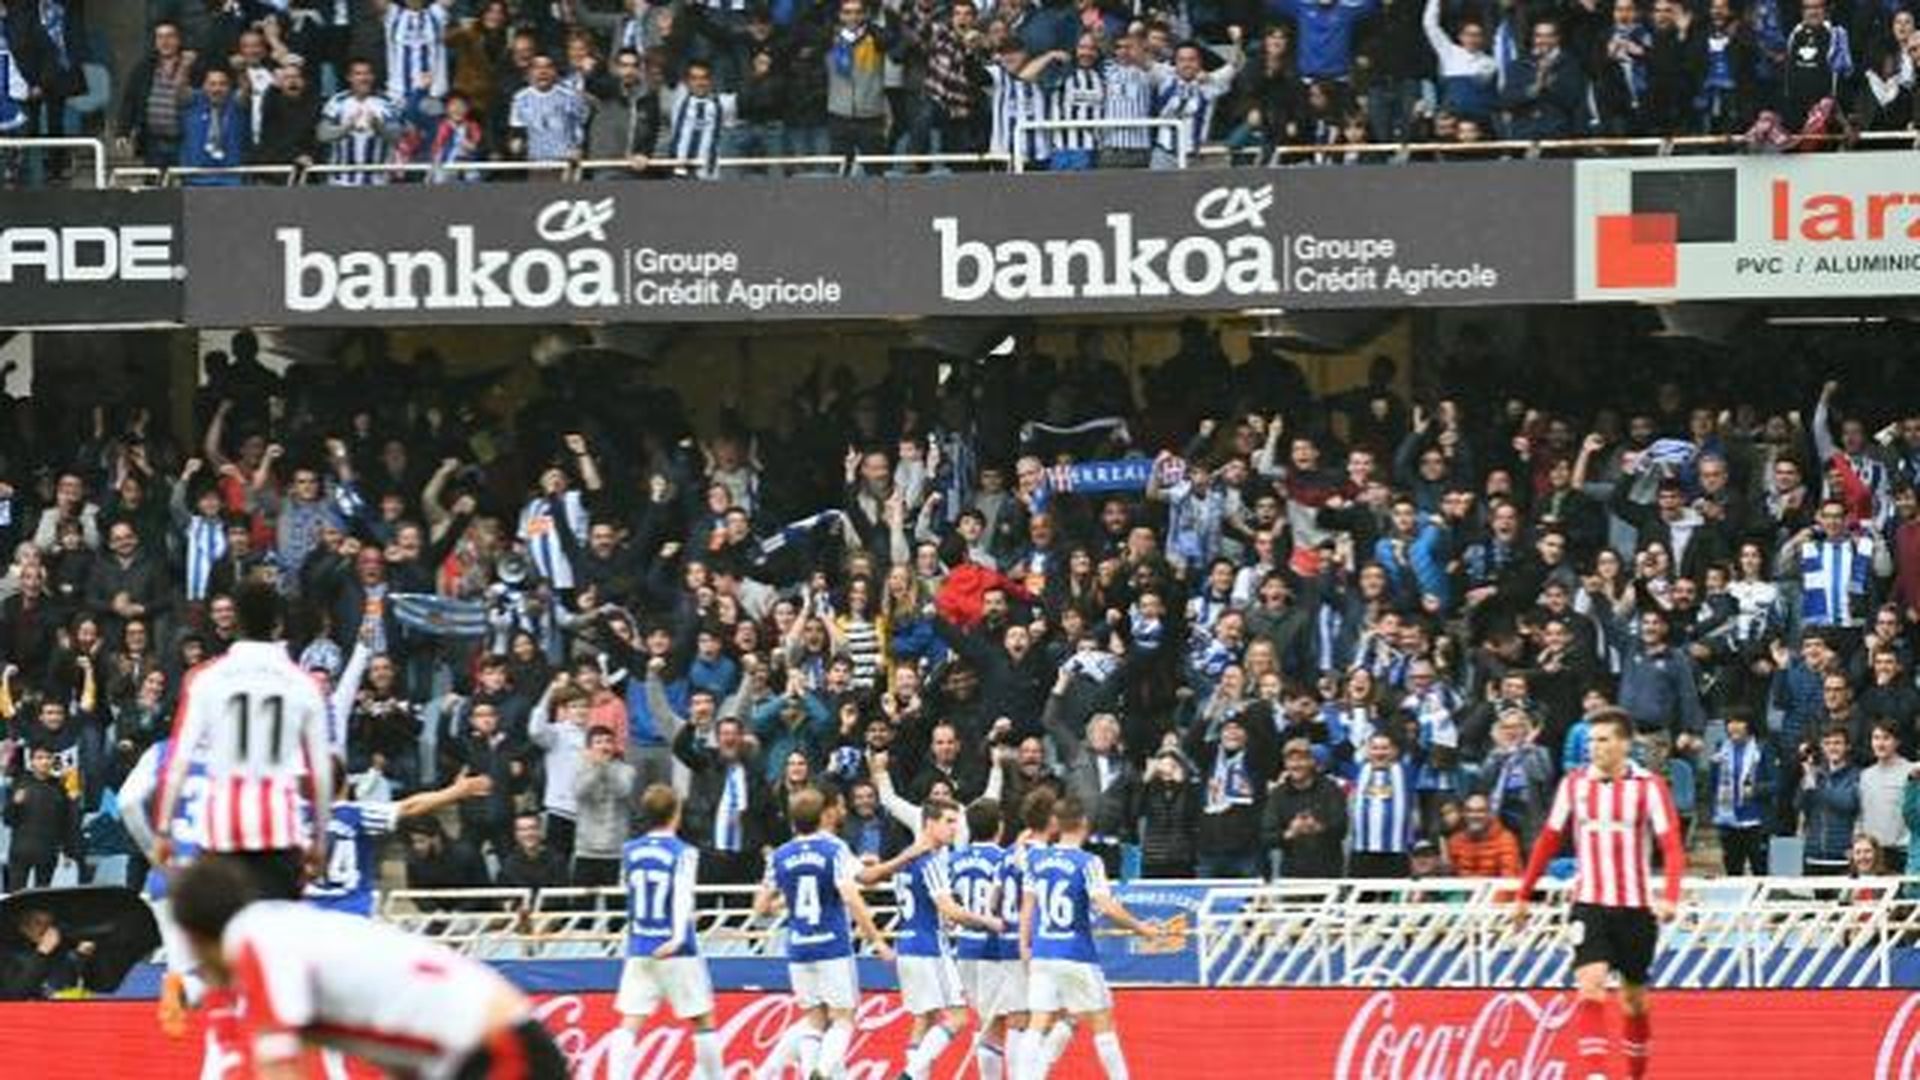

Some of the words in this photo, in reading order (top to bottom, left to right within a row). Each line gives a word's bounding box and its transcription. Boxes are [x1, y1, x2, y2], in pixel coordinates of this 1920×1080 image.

[276, 226, 618, 311] bankoa
[635, 248, 739, 276] Groupe
[932, 213, 1278, 300] bankoa
[1294, 234, 1395, 263] Groupe
[1736, 256, 1783, 274] PVC
[635, 277, 720, 305] Crédit
[726, 274, 841, 310] Agricole
[1294, 265, 1377, 292] Crédit
[1383, 263, 1498, 295] Agricole
[229, 691, 284, 766] 11
[629, 869, 670, 919] 17
[795, 875, 820, 925] 4
[955, 874, 993, 918] 18
[1034, 876, 1074, 928] 16
